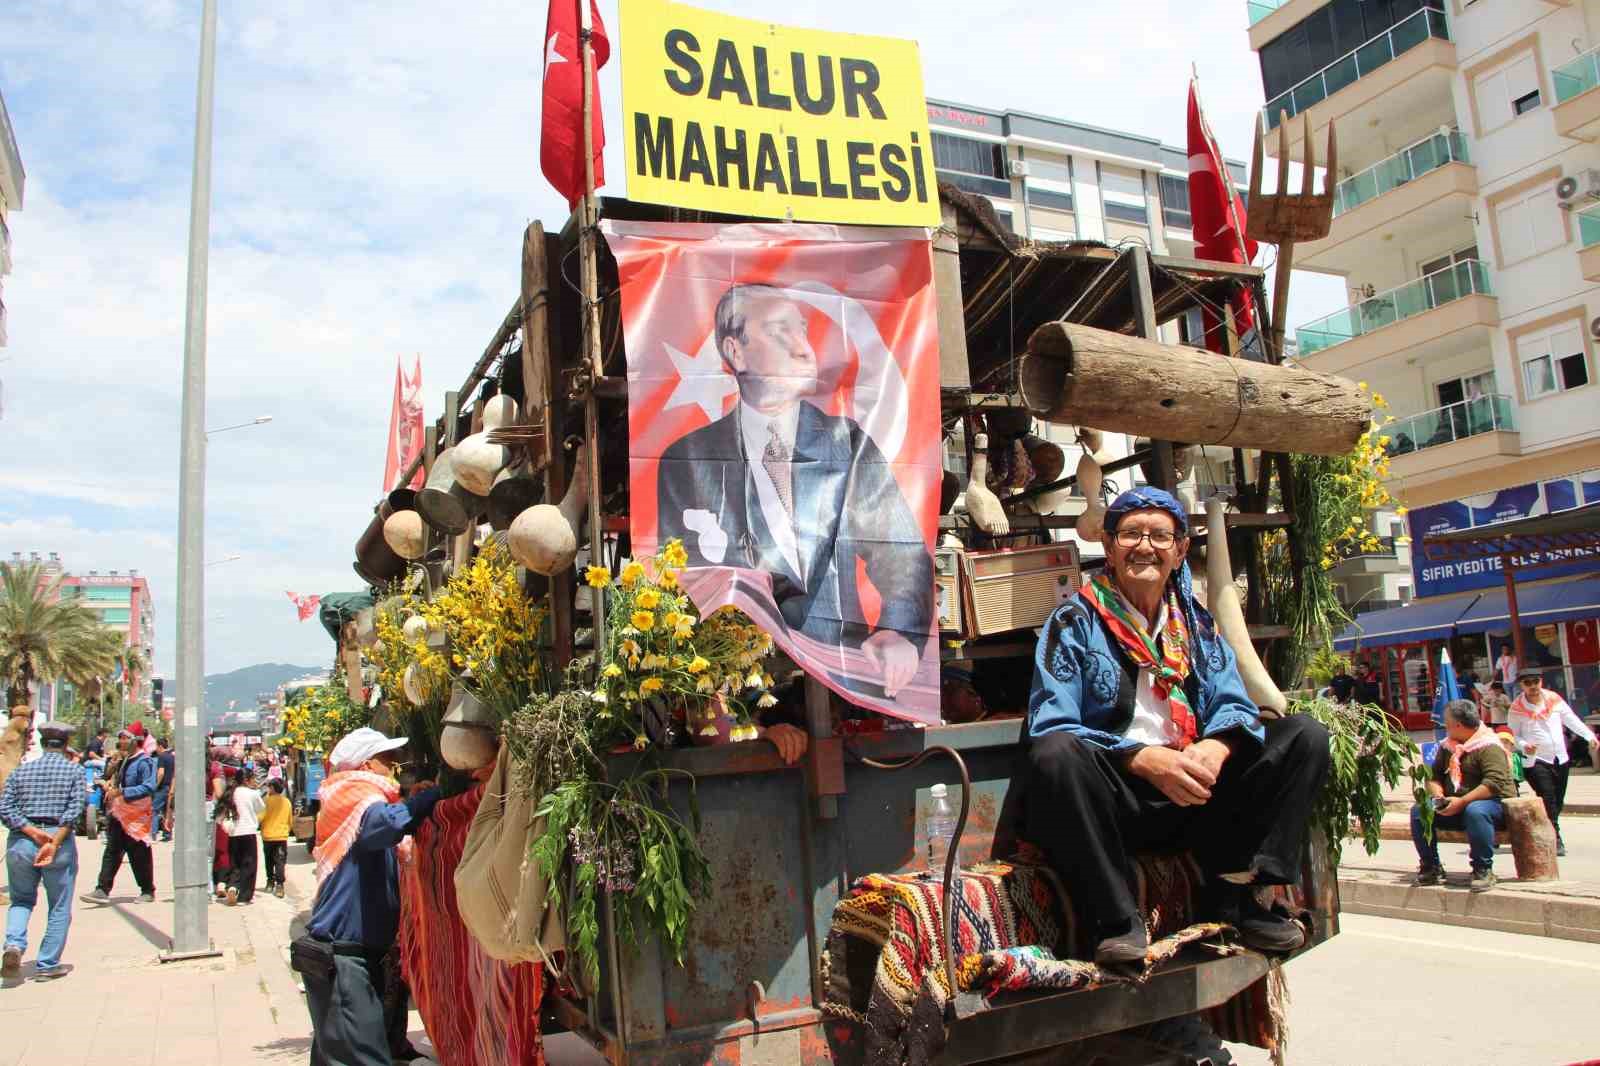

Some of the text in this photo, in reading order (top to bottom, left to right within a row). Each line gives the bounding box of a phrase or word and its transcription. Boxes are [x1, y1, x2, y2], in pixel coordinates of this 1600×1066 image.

[663, 28, 888, 121] SALUR
[633, 111, 929, 204] MAHALLESİ
[1422, 564, 1454, 582] SIFIR
[1454, 558, 1485, 577] YEDİ
